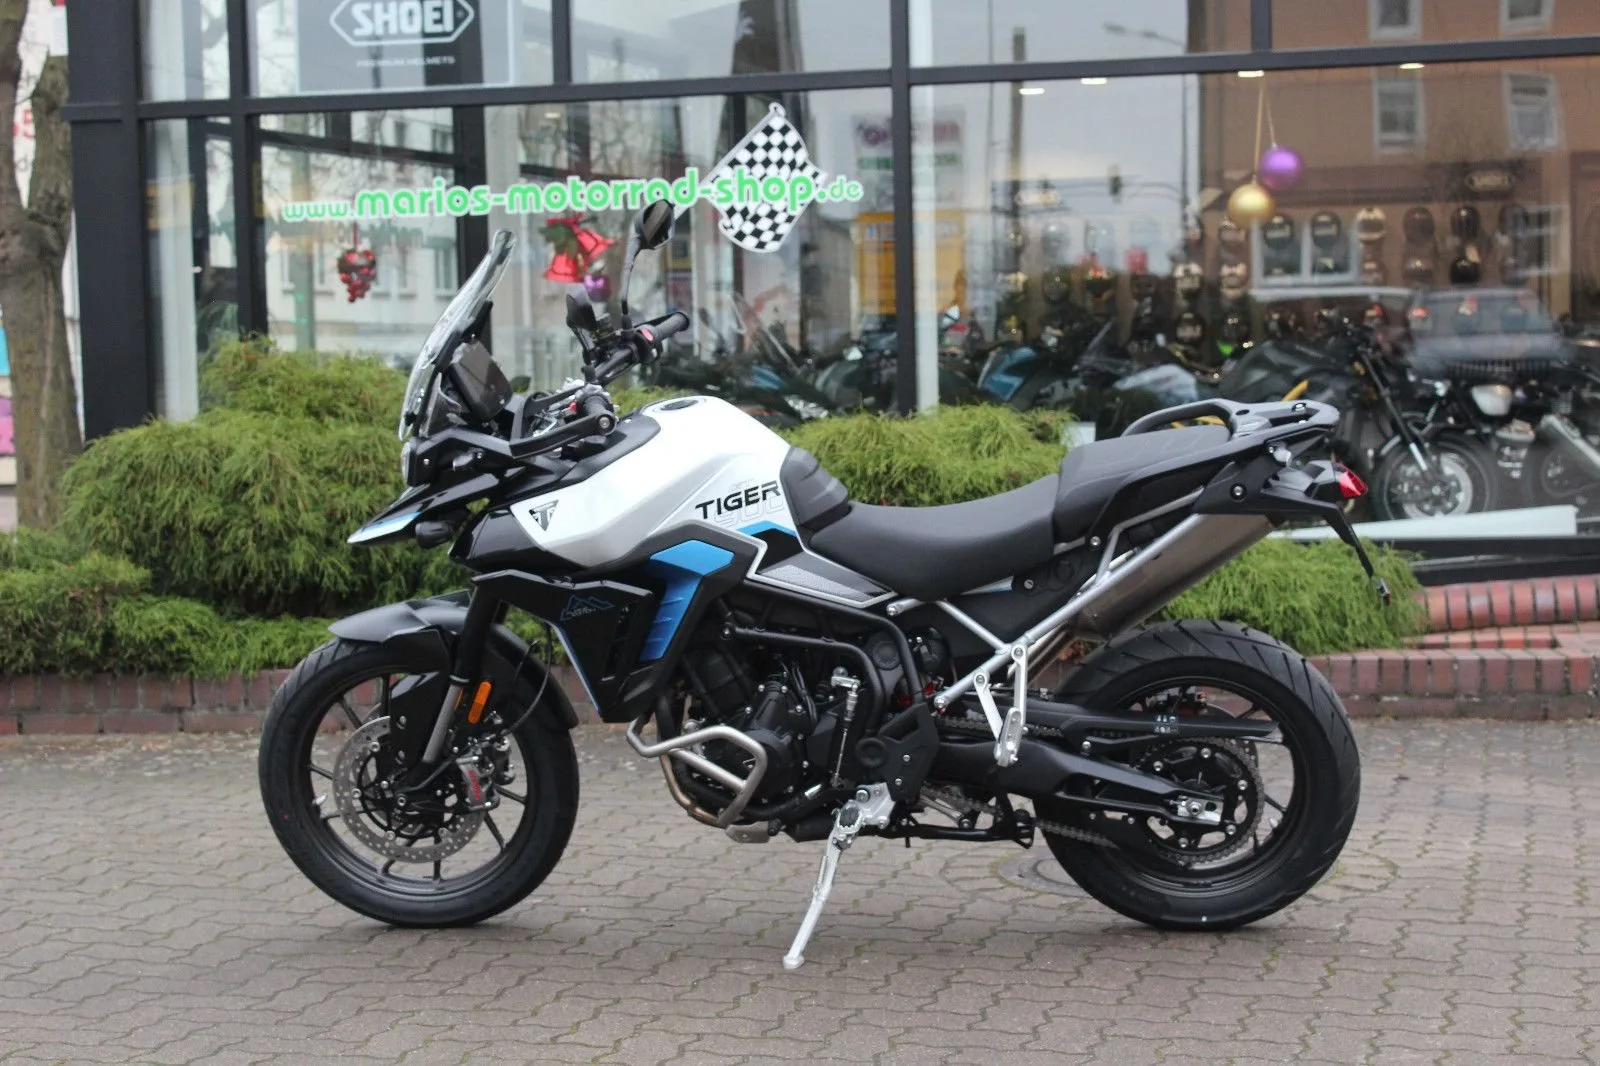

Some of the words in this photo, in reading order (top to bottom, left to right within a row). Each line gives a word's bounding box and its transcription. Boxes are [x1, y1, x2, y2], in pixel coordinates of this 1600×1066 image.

[351, 0, 454, 36] SHOEI
[282, 167, 863, 221] www.marios-motorrad-shop.de
[695, 480, 781, 519] TIGER
